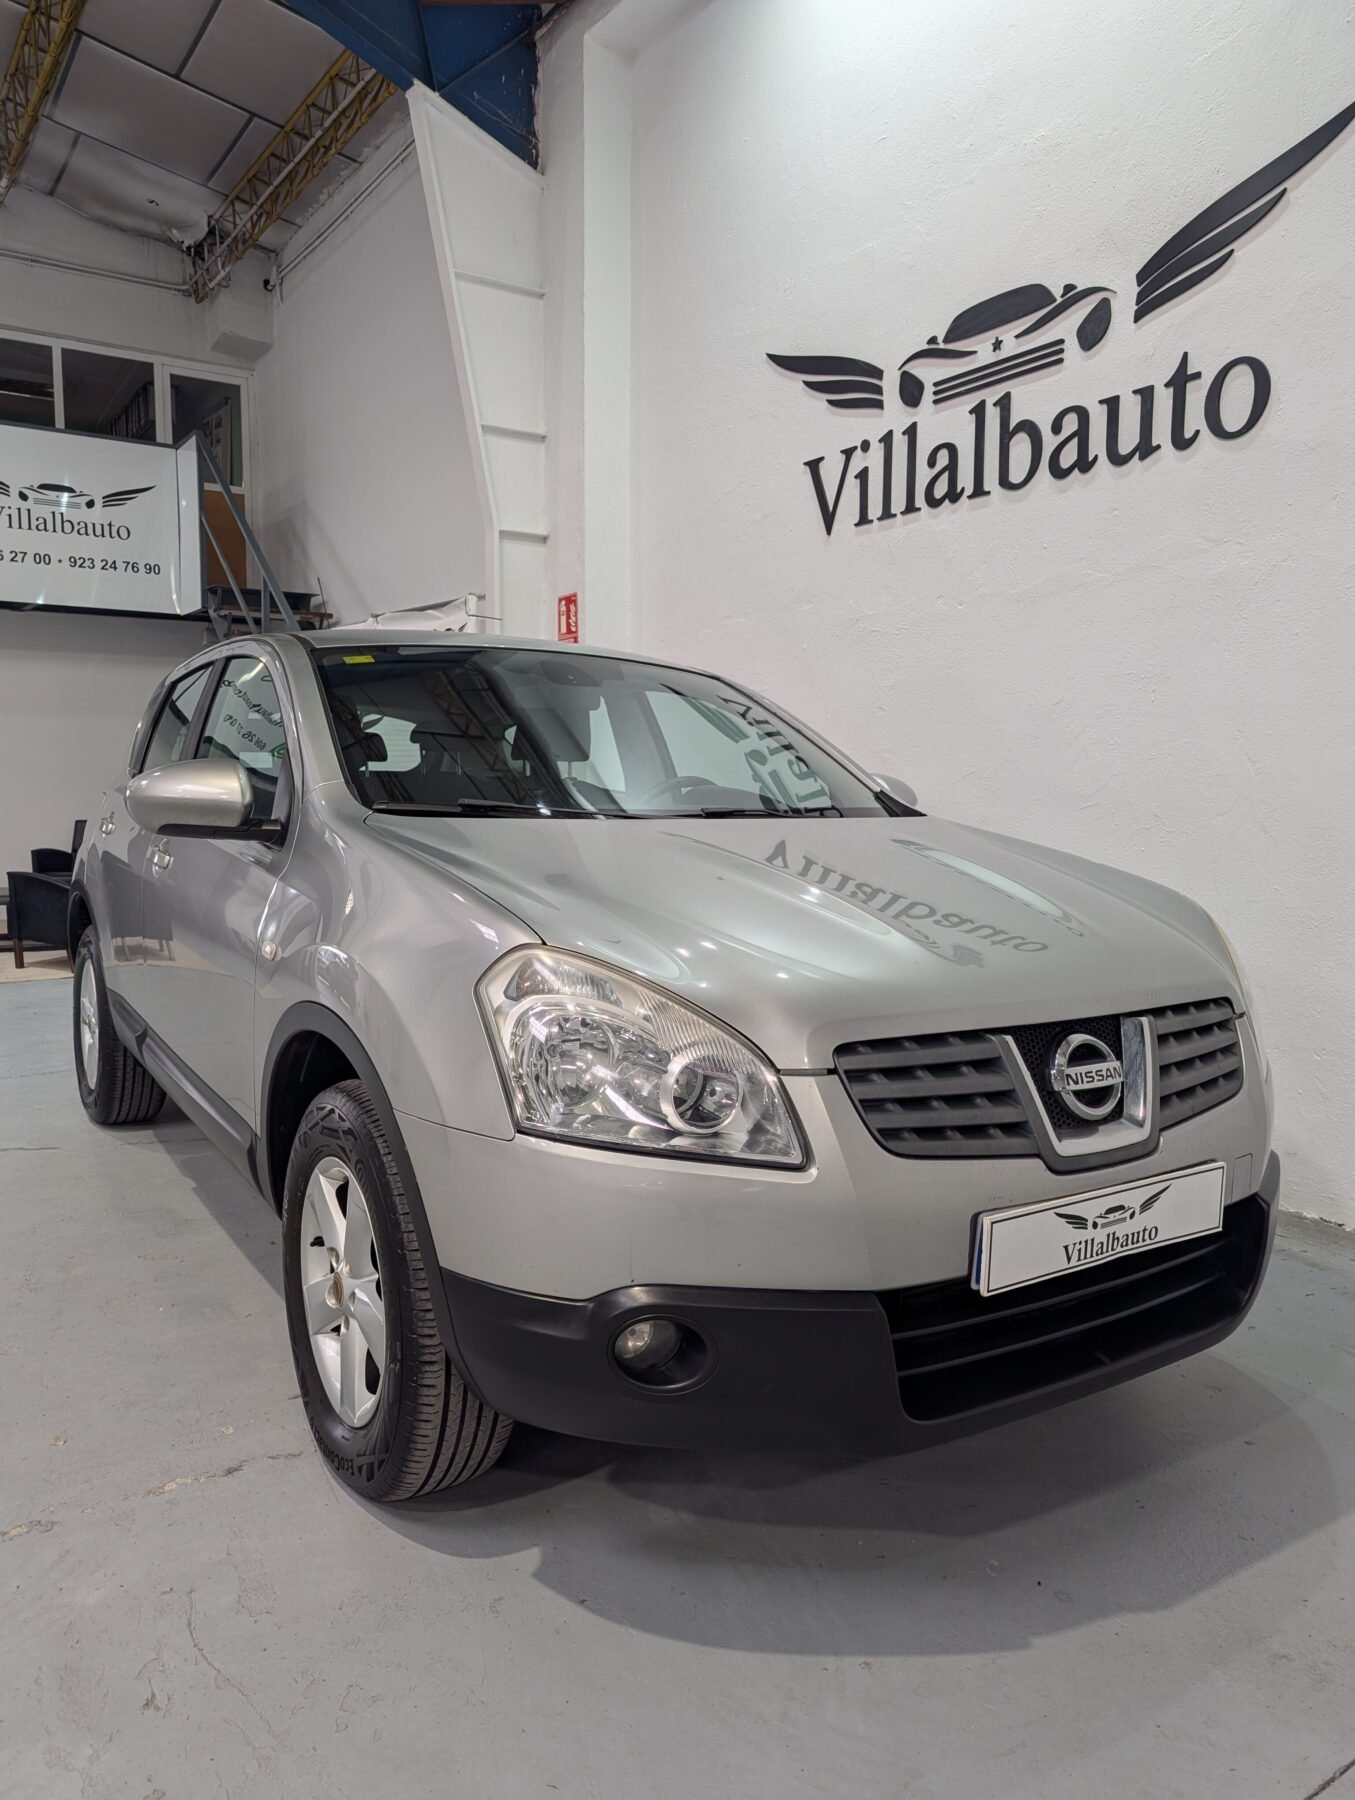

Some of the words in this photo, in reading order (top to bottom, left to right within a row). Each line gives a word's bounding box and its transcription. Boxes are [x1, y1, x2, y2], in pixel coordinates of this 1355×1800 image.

[804, 351, 1272, 536] Villalbauto
[0, 505, 131, 541] illalbauto
[9, 550, 28, 563] 27
[33, 552, 52, 566] 00
[68, 555, 96, 570] 923
[100, 558, 118, 572] 24
[122, 560, 140, 574] 76
[144, 563, 161, 576] 90
[1065, 1065, 1122, 1086] NISSAN
[1062, 1223, 1159, 1265] Villalbauto
